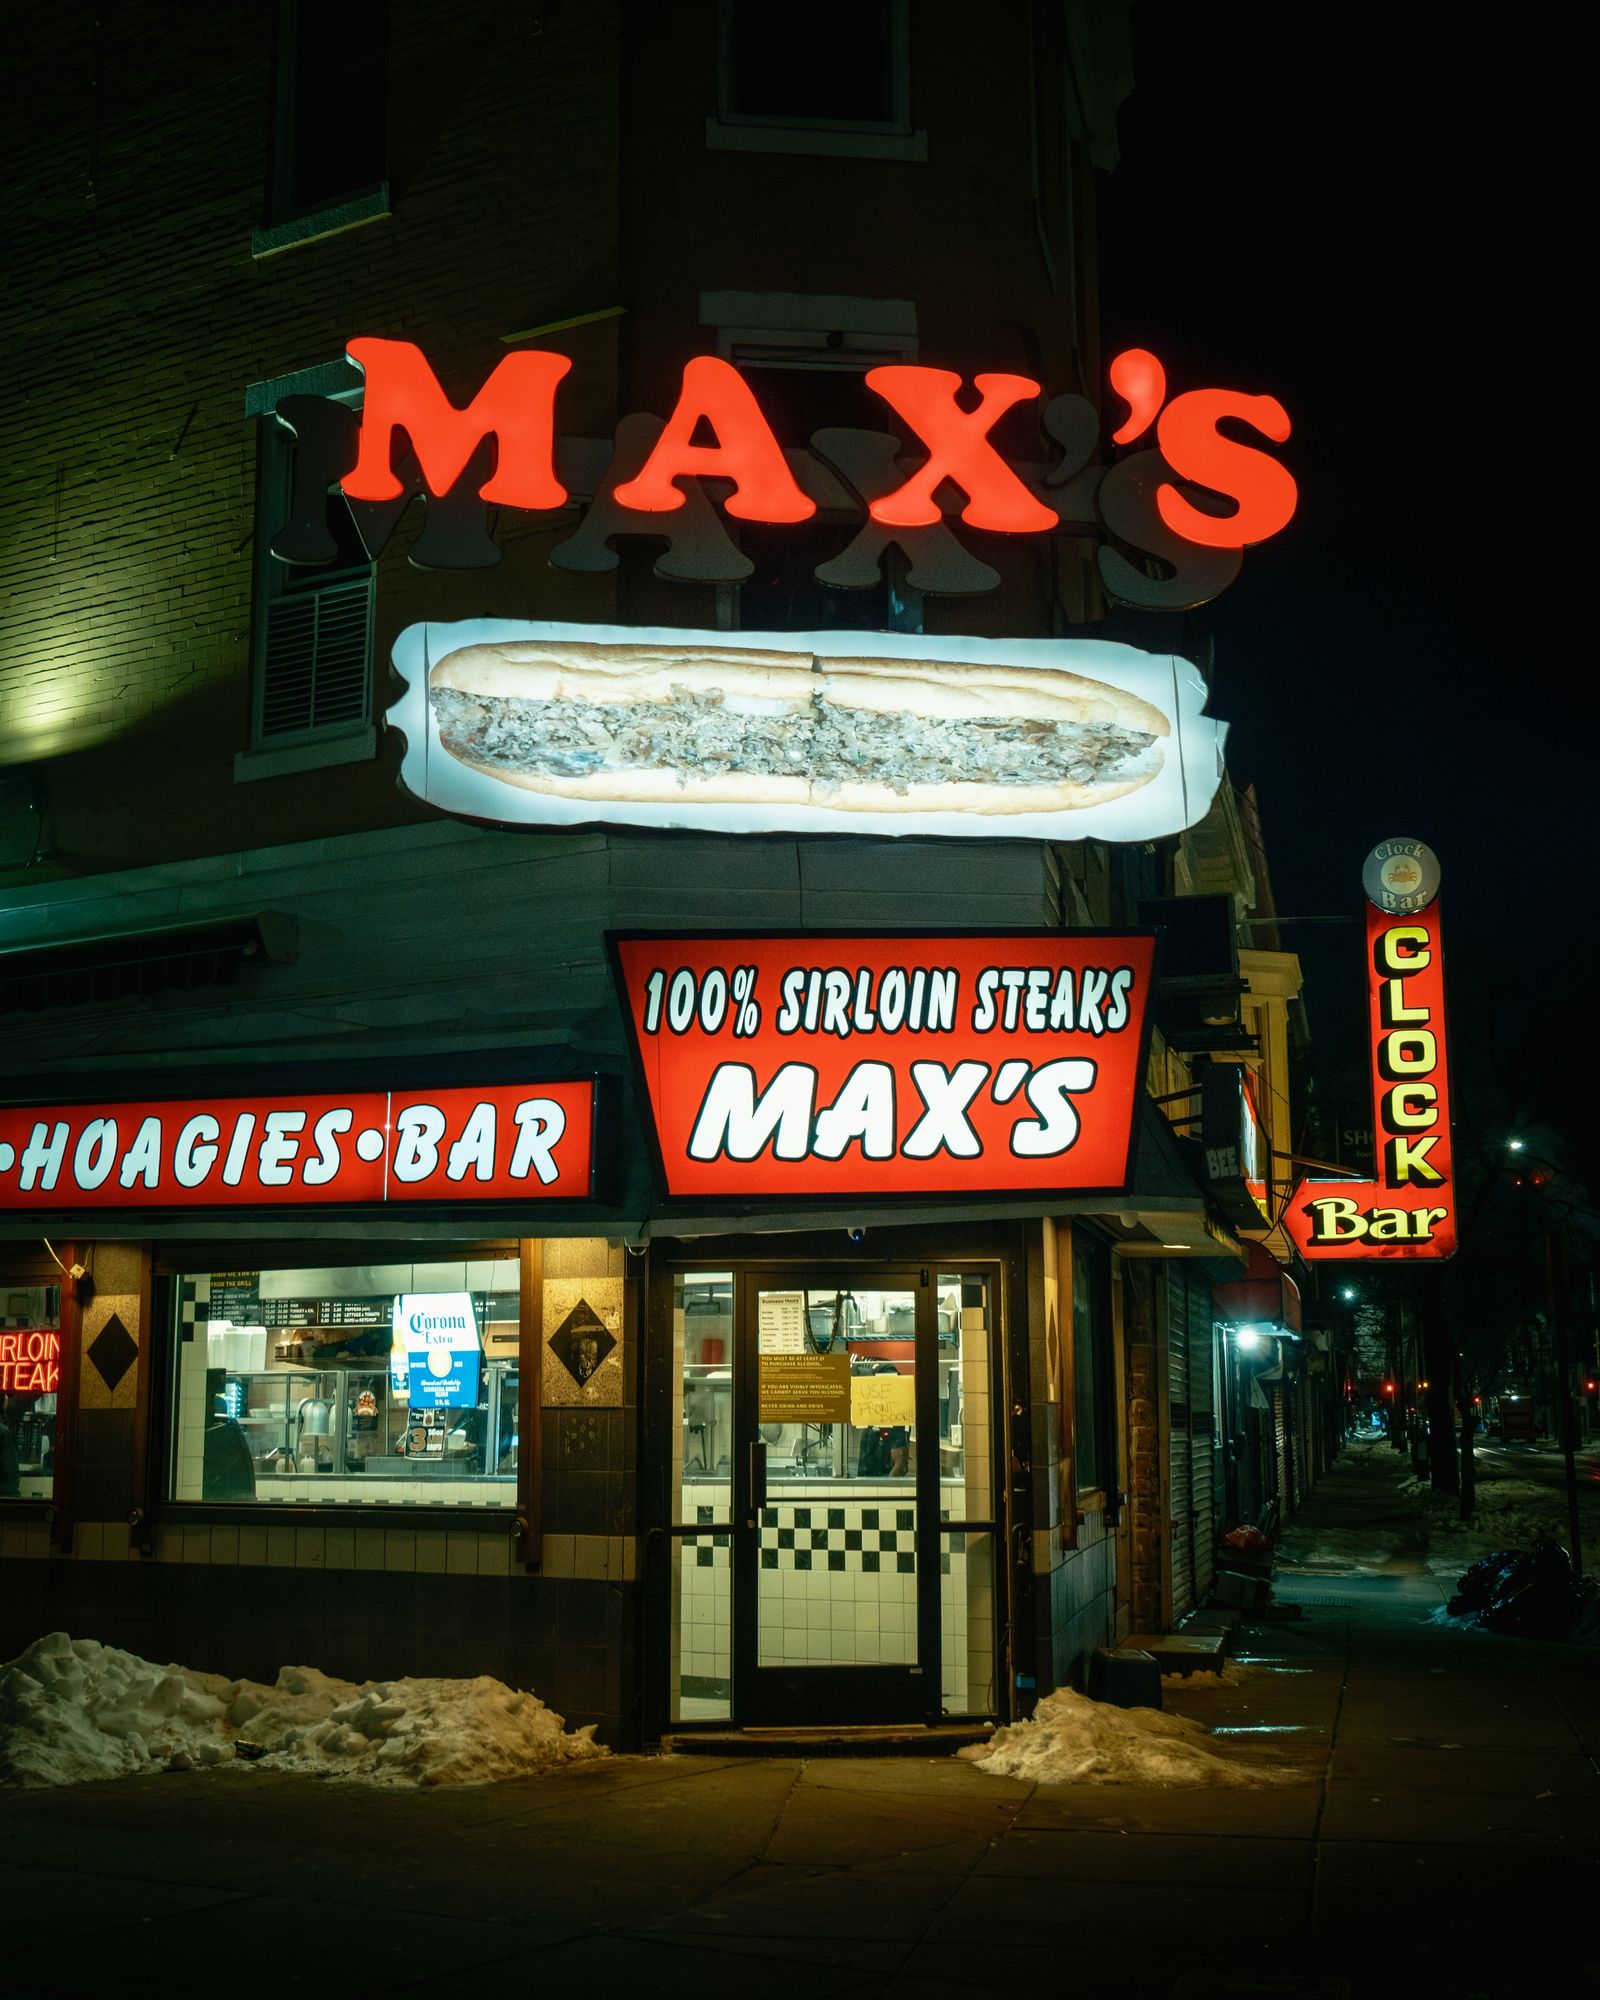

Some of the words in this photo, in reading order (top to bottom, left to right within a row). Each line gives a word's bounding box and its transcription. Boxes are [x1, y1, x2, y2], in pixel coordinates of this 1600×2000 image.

[340, 336, 1298, 548] MAX'S
[1374, 843, 1425, 860] Clock
[1380, 890, 1428, 909] Bar
[644, 965, 760, 1037] 100%
[777, 965, 959, 1038] SIRLOIN
[972, 965, 1133, 1038] STEAKS
[1380, 926, 1445, 1184] CLOCK
[686, 1057, 1097, 1162] MAX'S
[19, 1107, 352, 1191] HOAGIES
[392, 1098, 566, 1185] BAR
[1308, 1197, 1448, 1242] Bar
[409, 1312, 466, 1334] Corona
[425, 1332, 453, 1344] Extra
[860, 1383, 893, 1400] USE
[857, 1400, 897, 1417] FRONT
